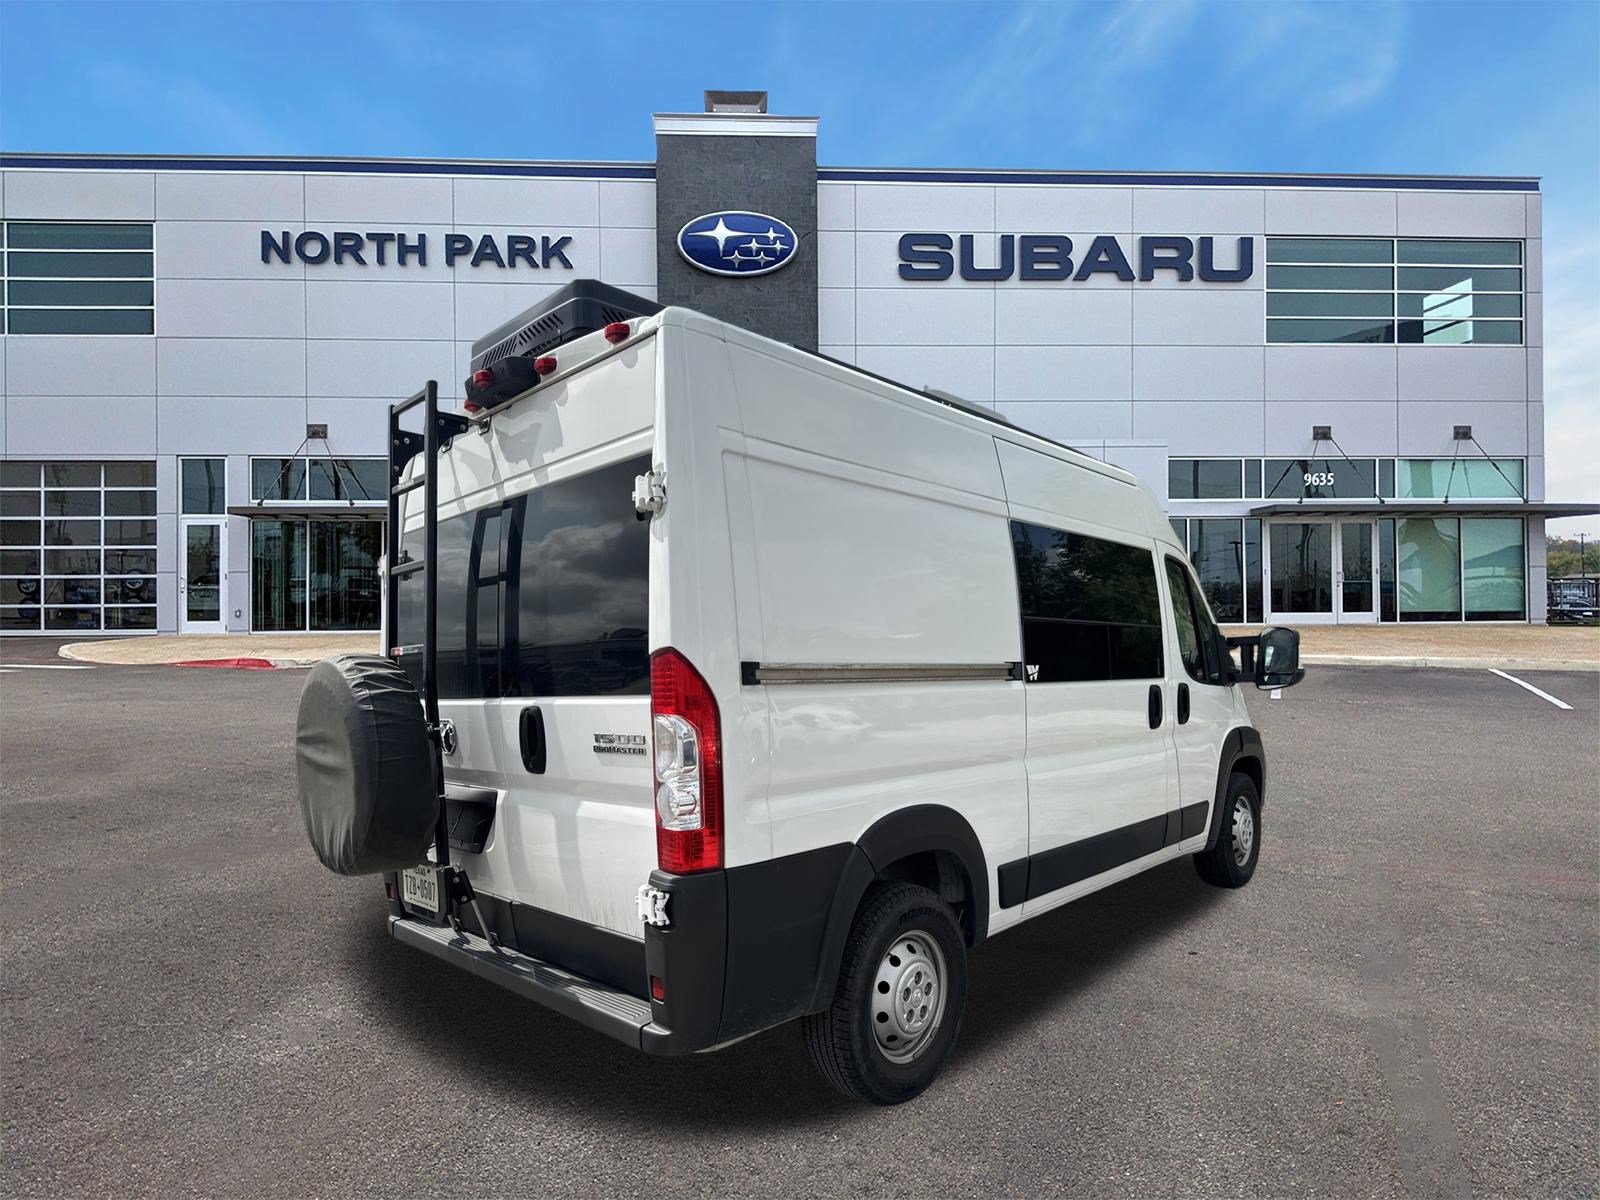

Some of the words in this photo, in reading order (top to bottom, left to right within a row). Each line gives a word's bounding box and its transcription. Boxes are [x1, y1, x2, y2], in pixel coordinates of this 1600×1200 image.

[261, 230, 427, 267] NORTH
[445, 233, 574, 269] PARK
[898, 233, 1254, 282] SUBARU
[1303, 472, 1335, 486] 9635
[593, 733, 646, 746] 1500
